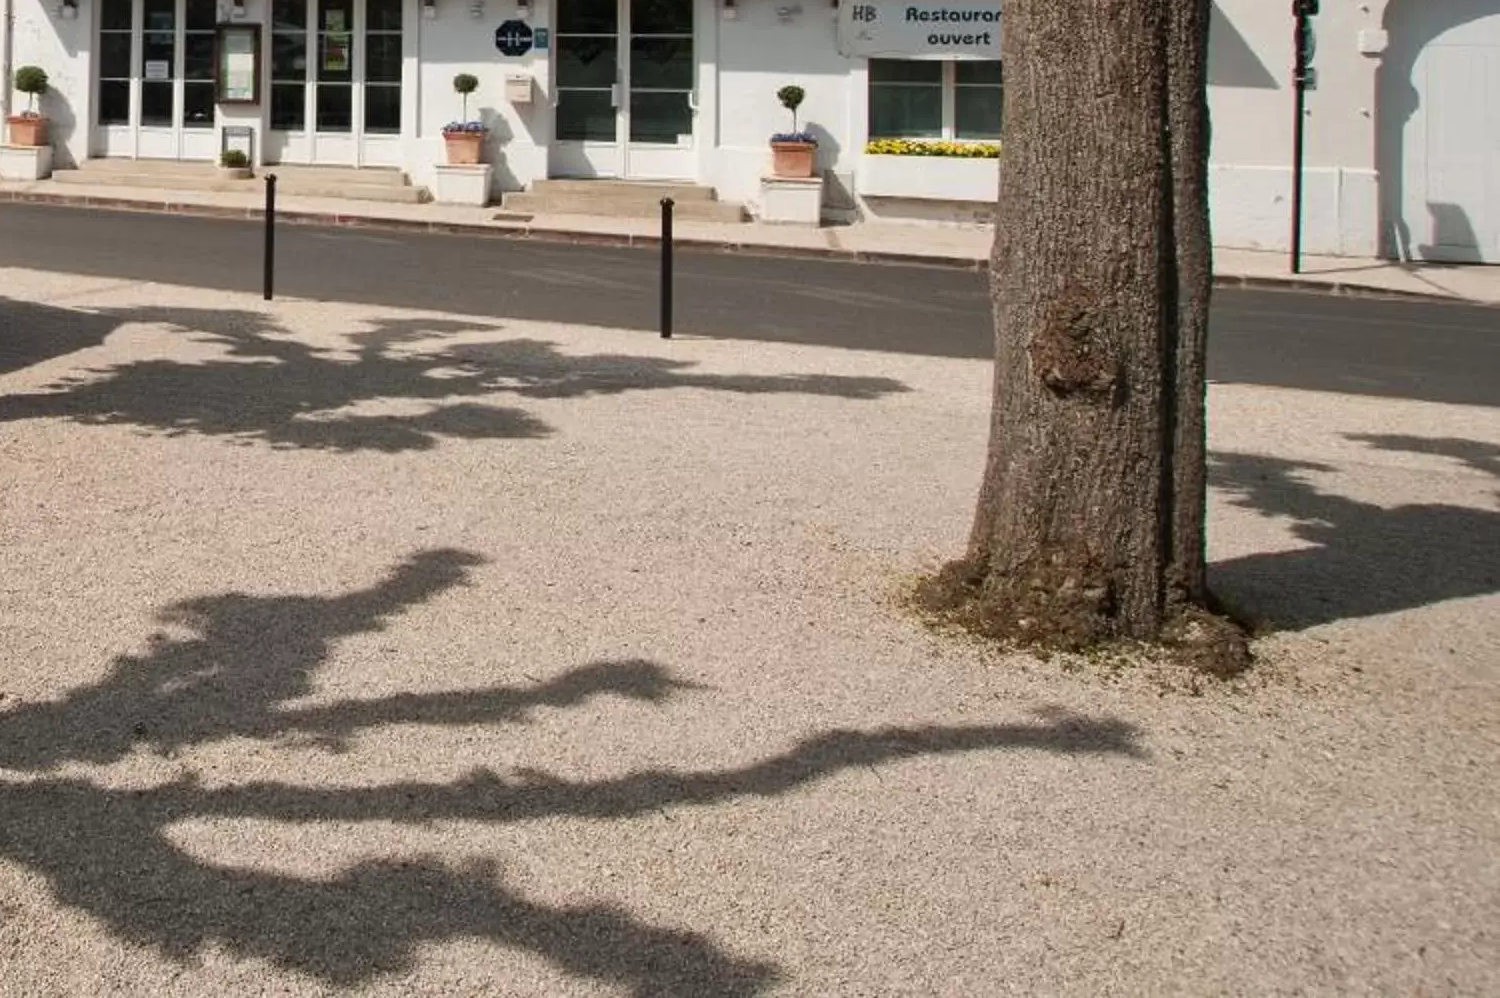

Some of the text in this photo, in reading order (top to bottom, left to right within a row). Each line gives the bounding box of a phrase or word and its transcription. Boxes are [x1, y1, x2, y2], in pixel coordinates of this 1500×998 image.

[852, 5, 877, 22] HB
[905, 7, 1003, 22] Restauran
[927, 30, 992, 45] ouvert
